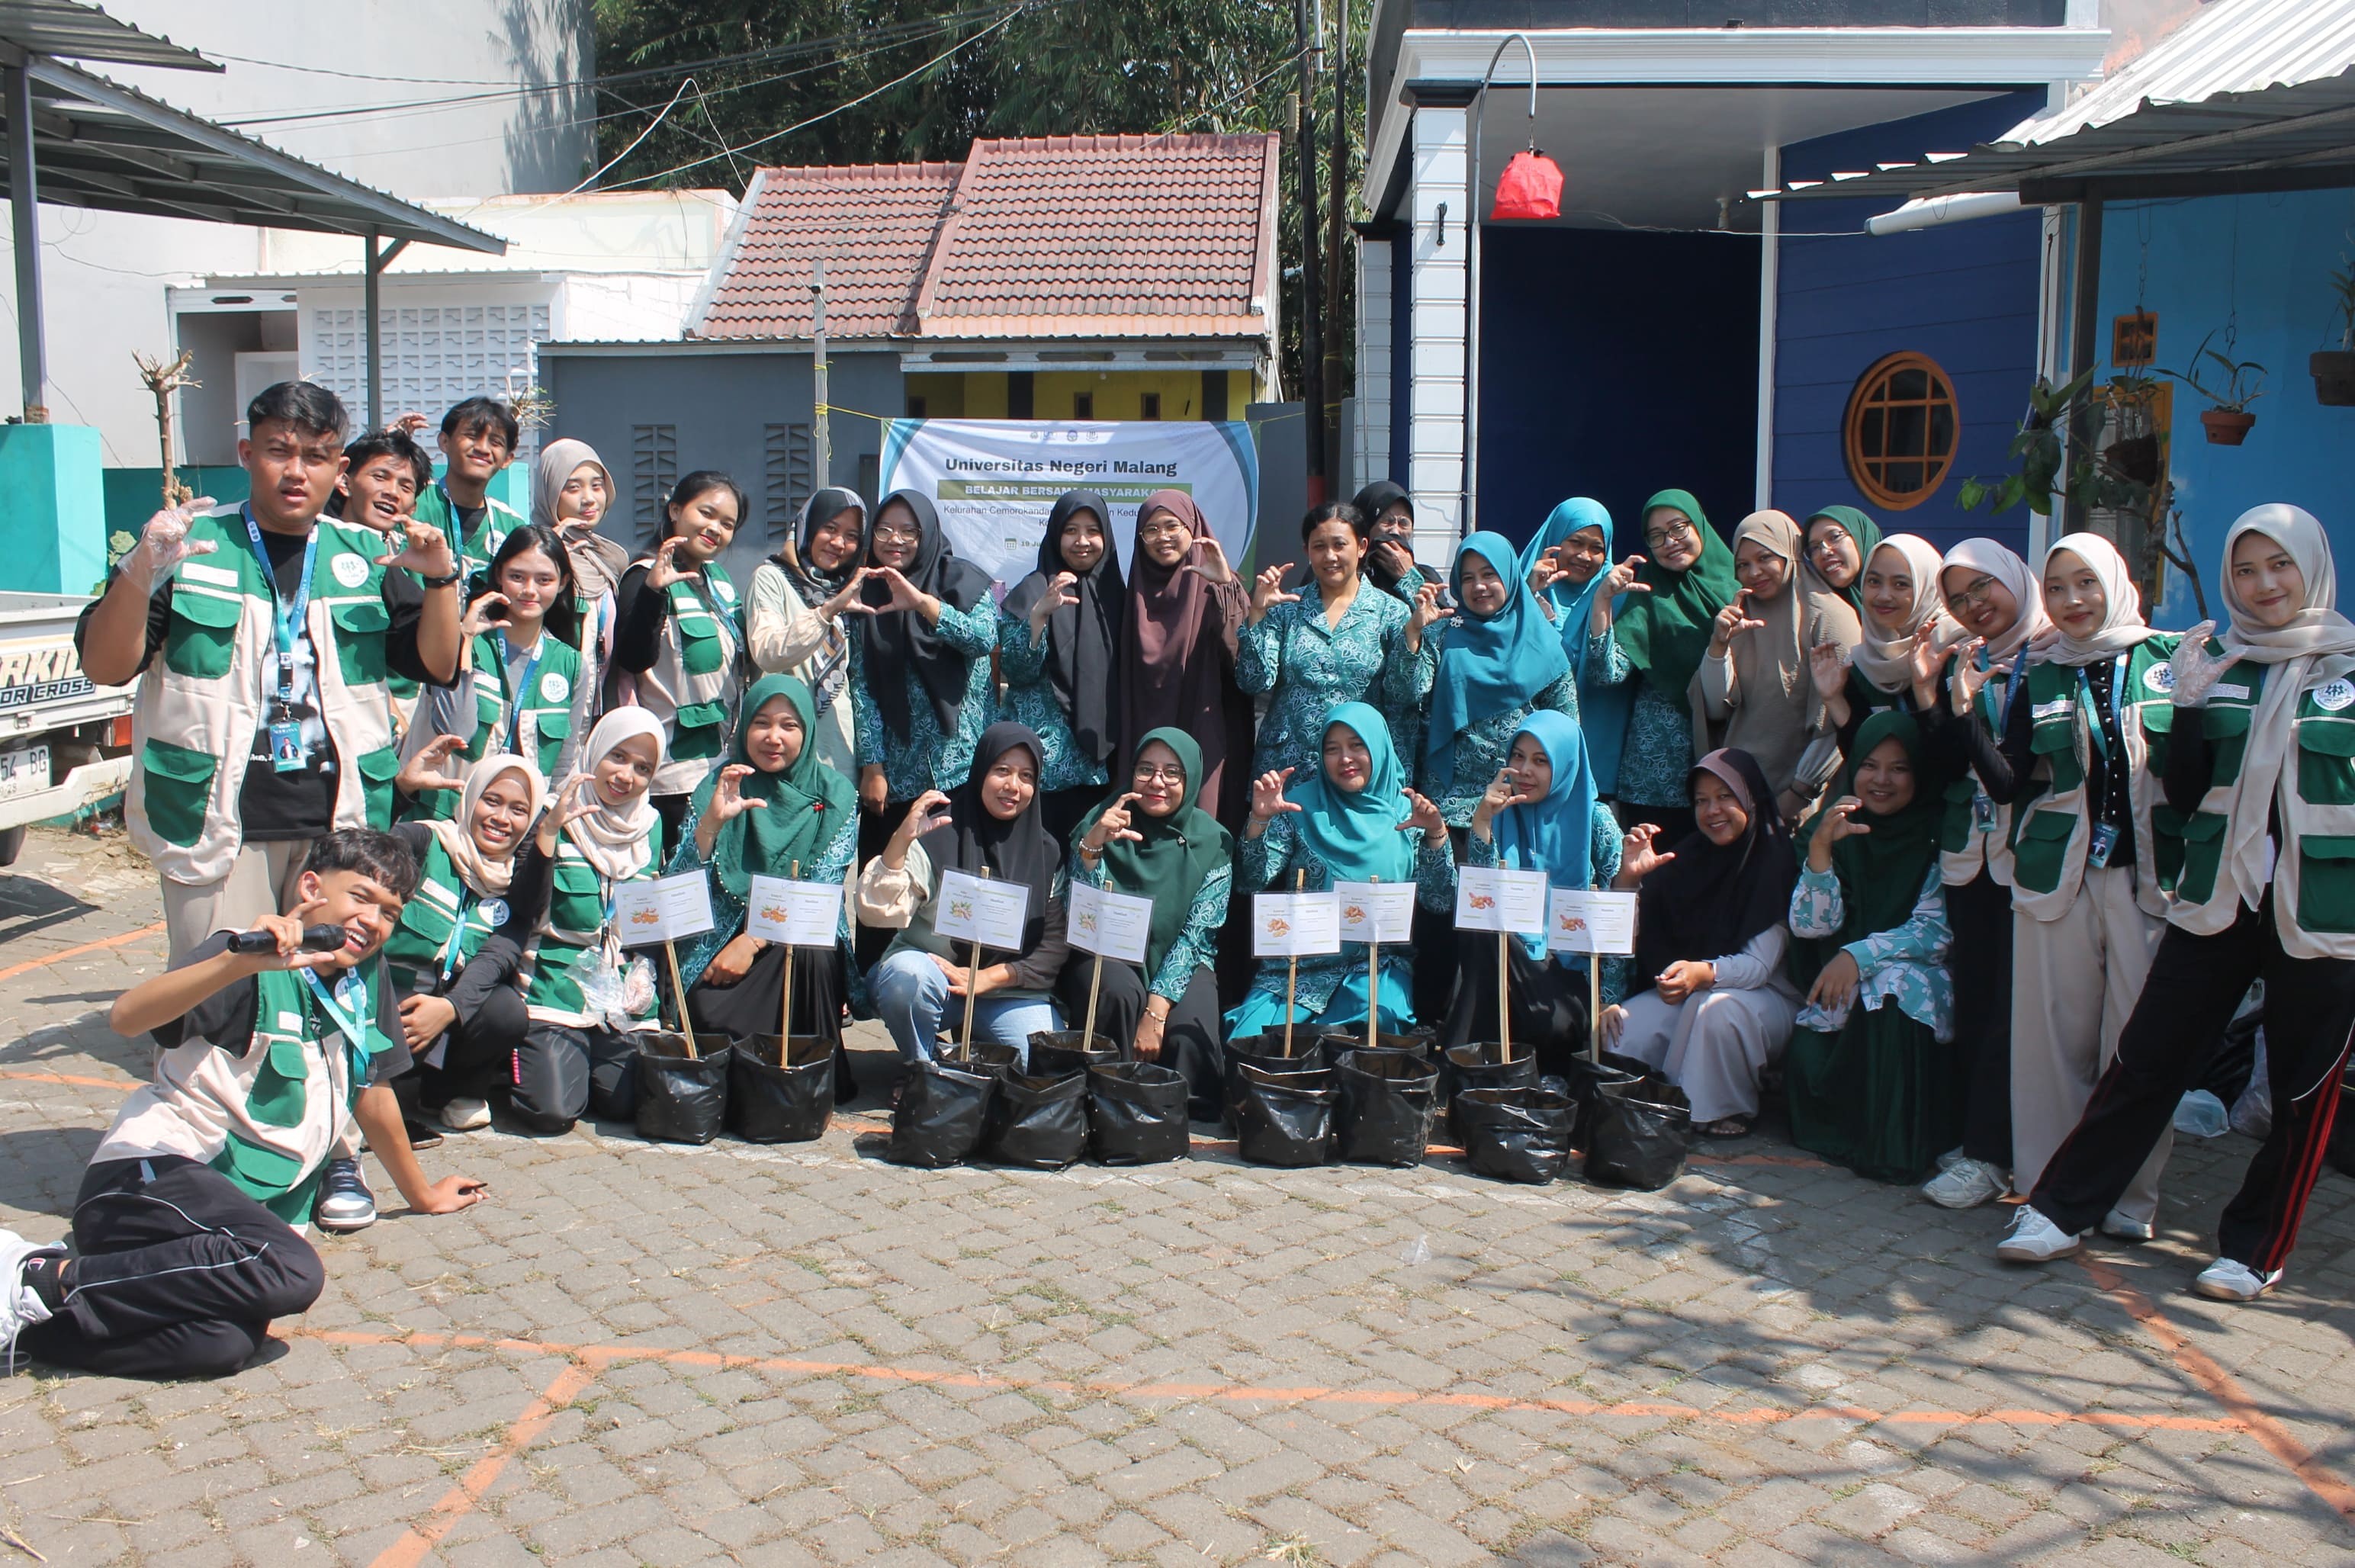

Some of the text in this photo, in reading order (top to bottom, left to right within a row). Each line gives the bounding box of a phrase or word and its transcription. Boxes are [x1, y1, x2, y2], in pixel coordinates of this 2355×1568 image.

[946, 458, 1178, 477] Universitas Negeri Malang
[965, 485, 1019, 495] BELAJAR
[944, 506, 987, 515] Kelurahan
[989, 506, 1052, 516] Cemorokanda
[34, 679, 93, 699] CROSS
[30, 749, 47, 776] BG
